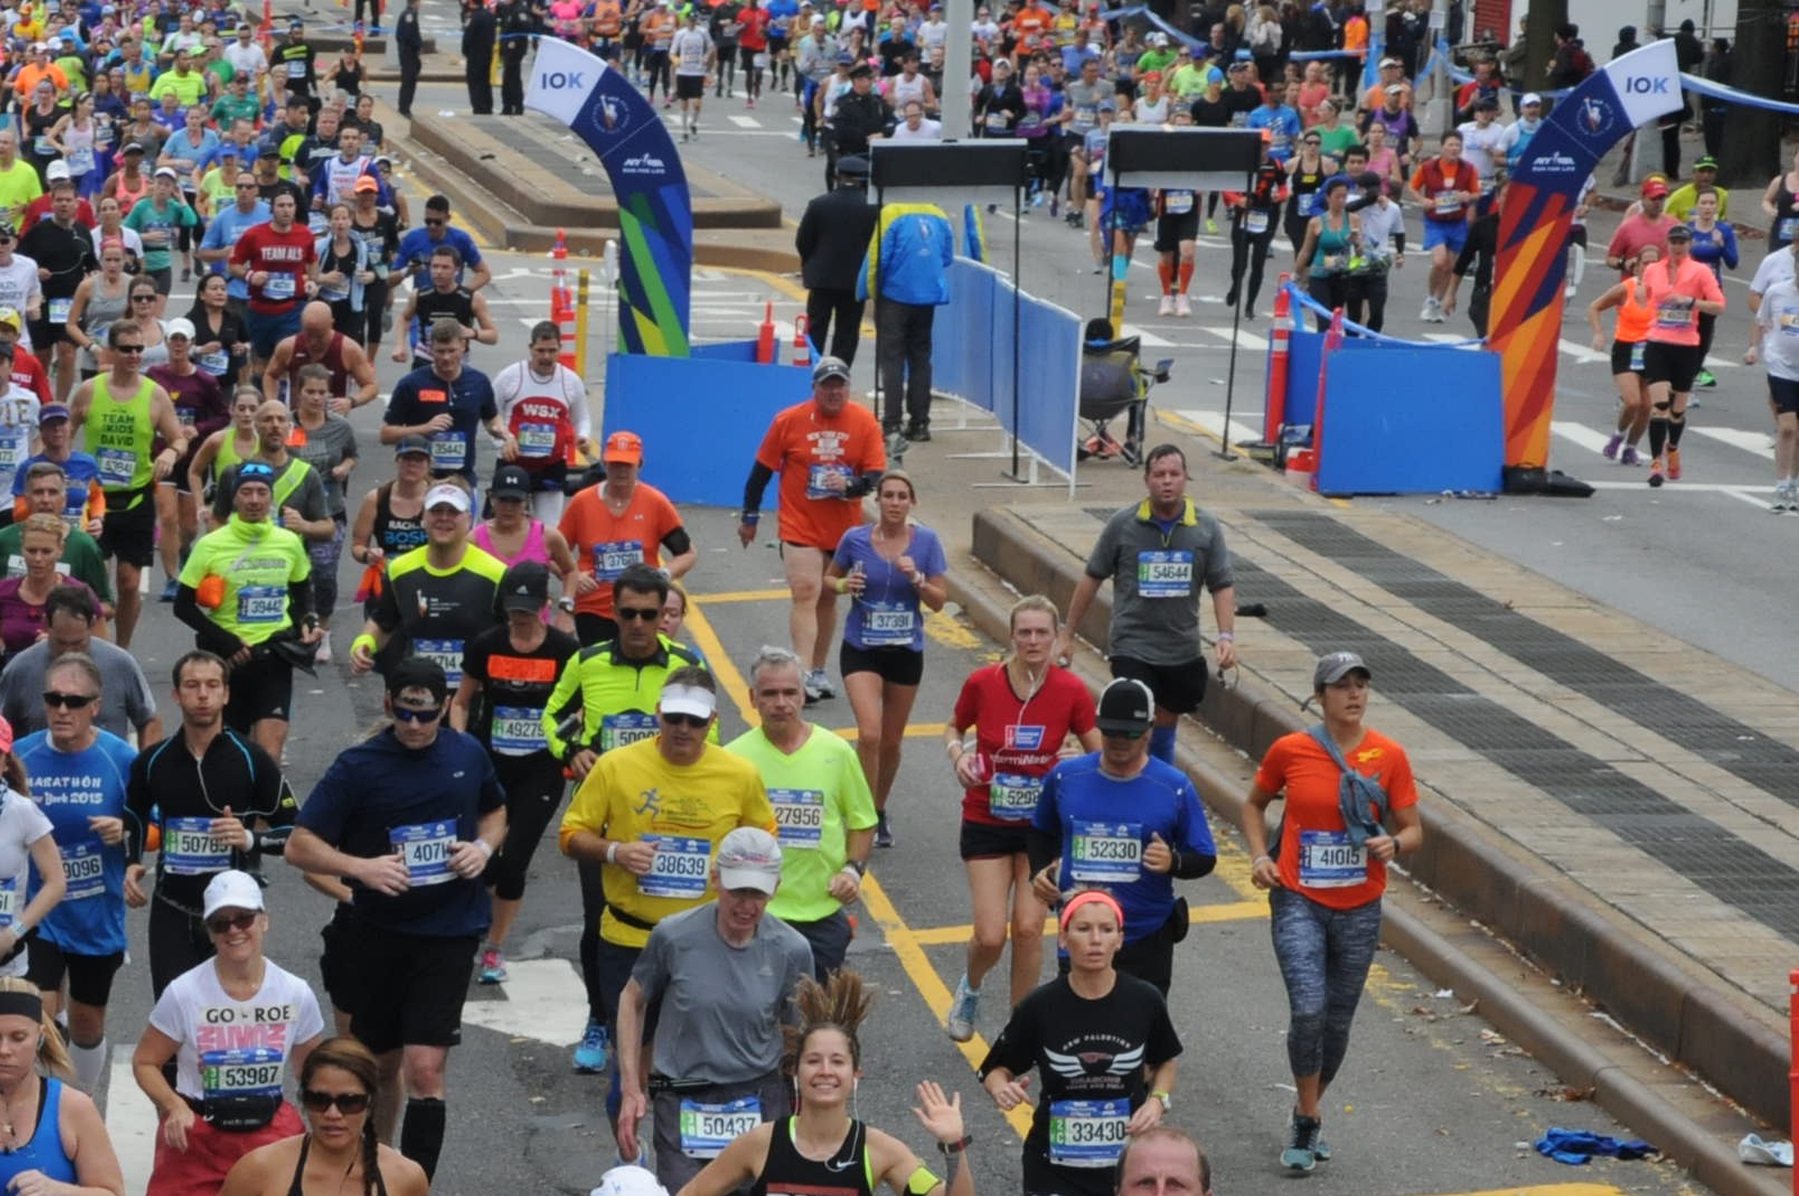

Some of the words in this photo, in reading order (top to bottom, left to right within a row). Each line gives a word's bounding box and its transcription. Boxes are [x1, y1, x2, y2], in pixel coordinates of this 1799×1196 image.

[542, 72, 583, 89] 10K
[1625, 77, 1668, 94] 10K
[261, 247, 287, 261] TEAM
[101, 413, 135, 424] TEAM
[522, 403, 561, 419] WSX
[101, 435, 134, 447] DAVID
[70, 792, 103, 805] 2015
[1007, 789, 1041, 806] 5298
[774, 806, 820, 827] 27956
[413, 842, 452, 862] 4071
[1090, 841, 1137, 860] 52330
[1320, 848, 1360, 867] 41015
[62, 857, 101, 880] 9096
[656, 854, 706, 876] 38639
[205, 1007, 237, 1023] GO
[254, 1004, 290, 1021] ROE
[225, 1065, 278, 1087] 53987
[1071, 1121, 1126, 1144] 33430
